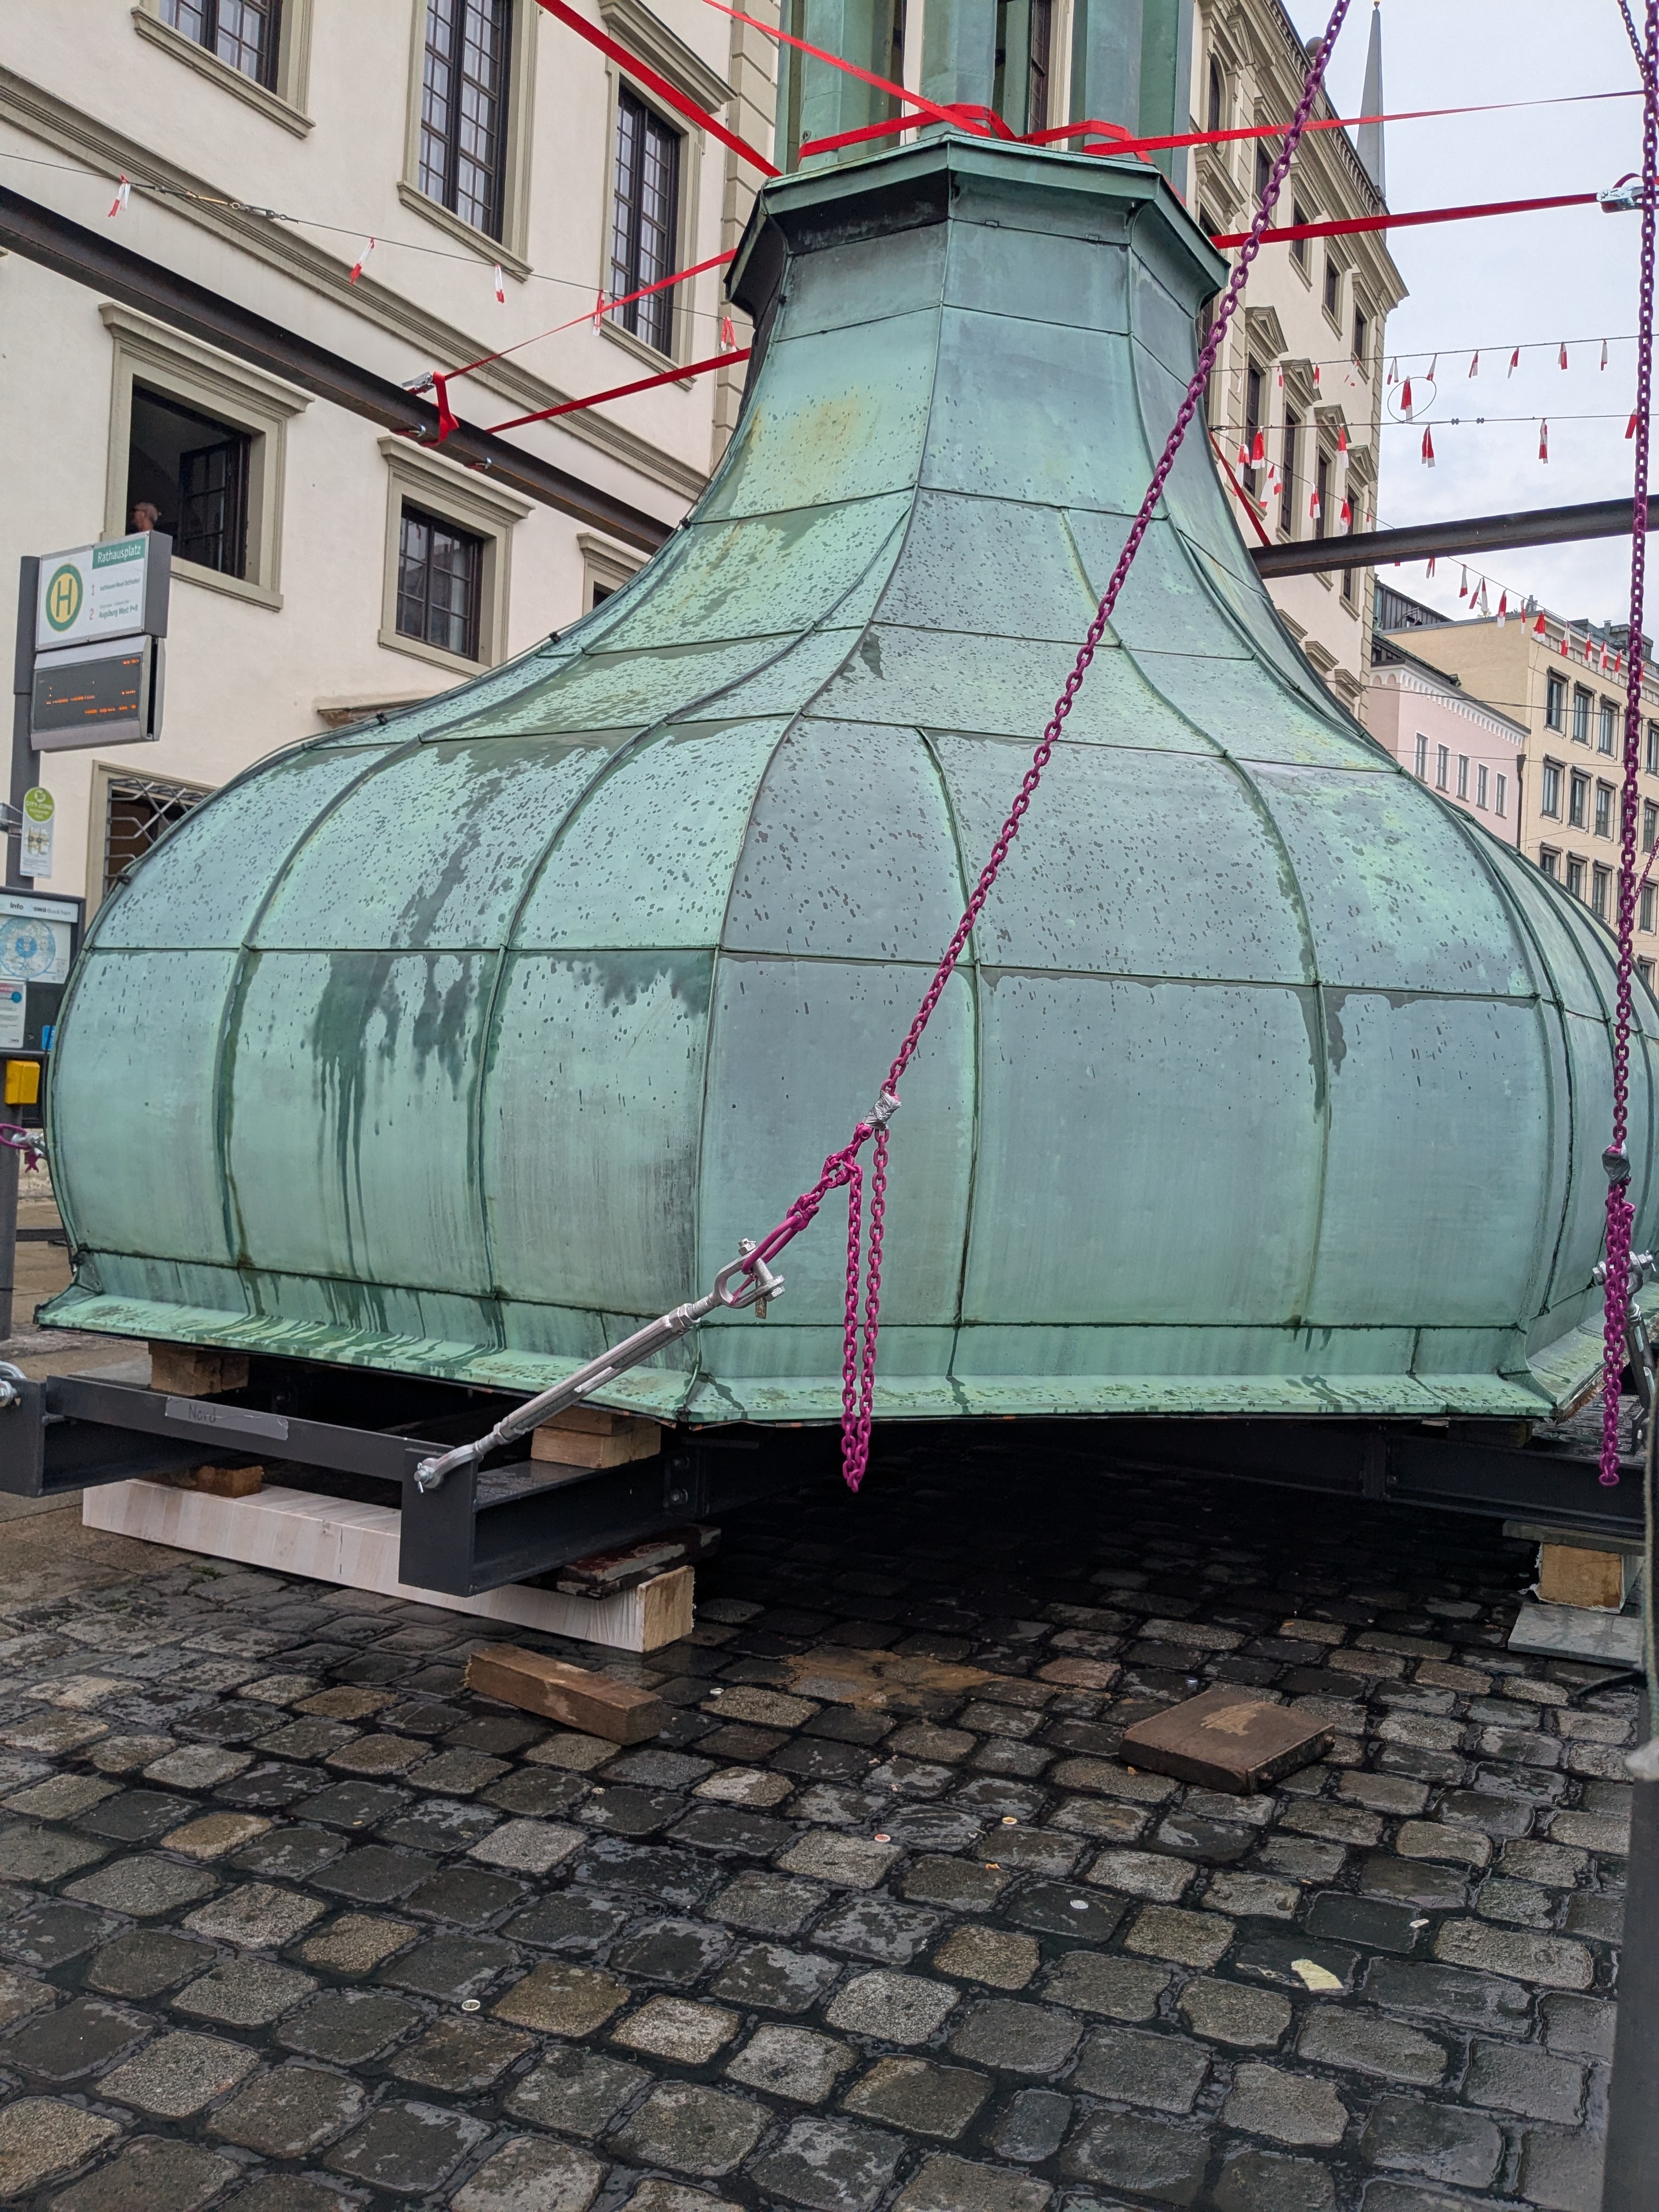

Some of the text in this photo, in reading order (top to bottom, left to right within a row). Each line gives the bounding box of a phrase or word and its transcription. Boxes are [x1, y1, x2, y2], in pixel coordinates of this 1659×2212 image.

[97, 544, 142, 563] Rathausplatz
[91, 584, 95, 596] 1
[56, 579, 73, 617] H
[89, 608, 94, 620] 2
[99, 610, 118, 619] Augsburg
[10, 902, 24, 910] Info
[189, 1404, 216, 1423] Nord
